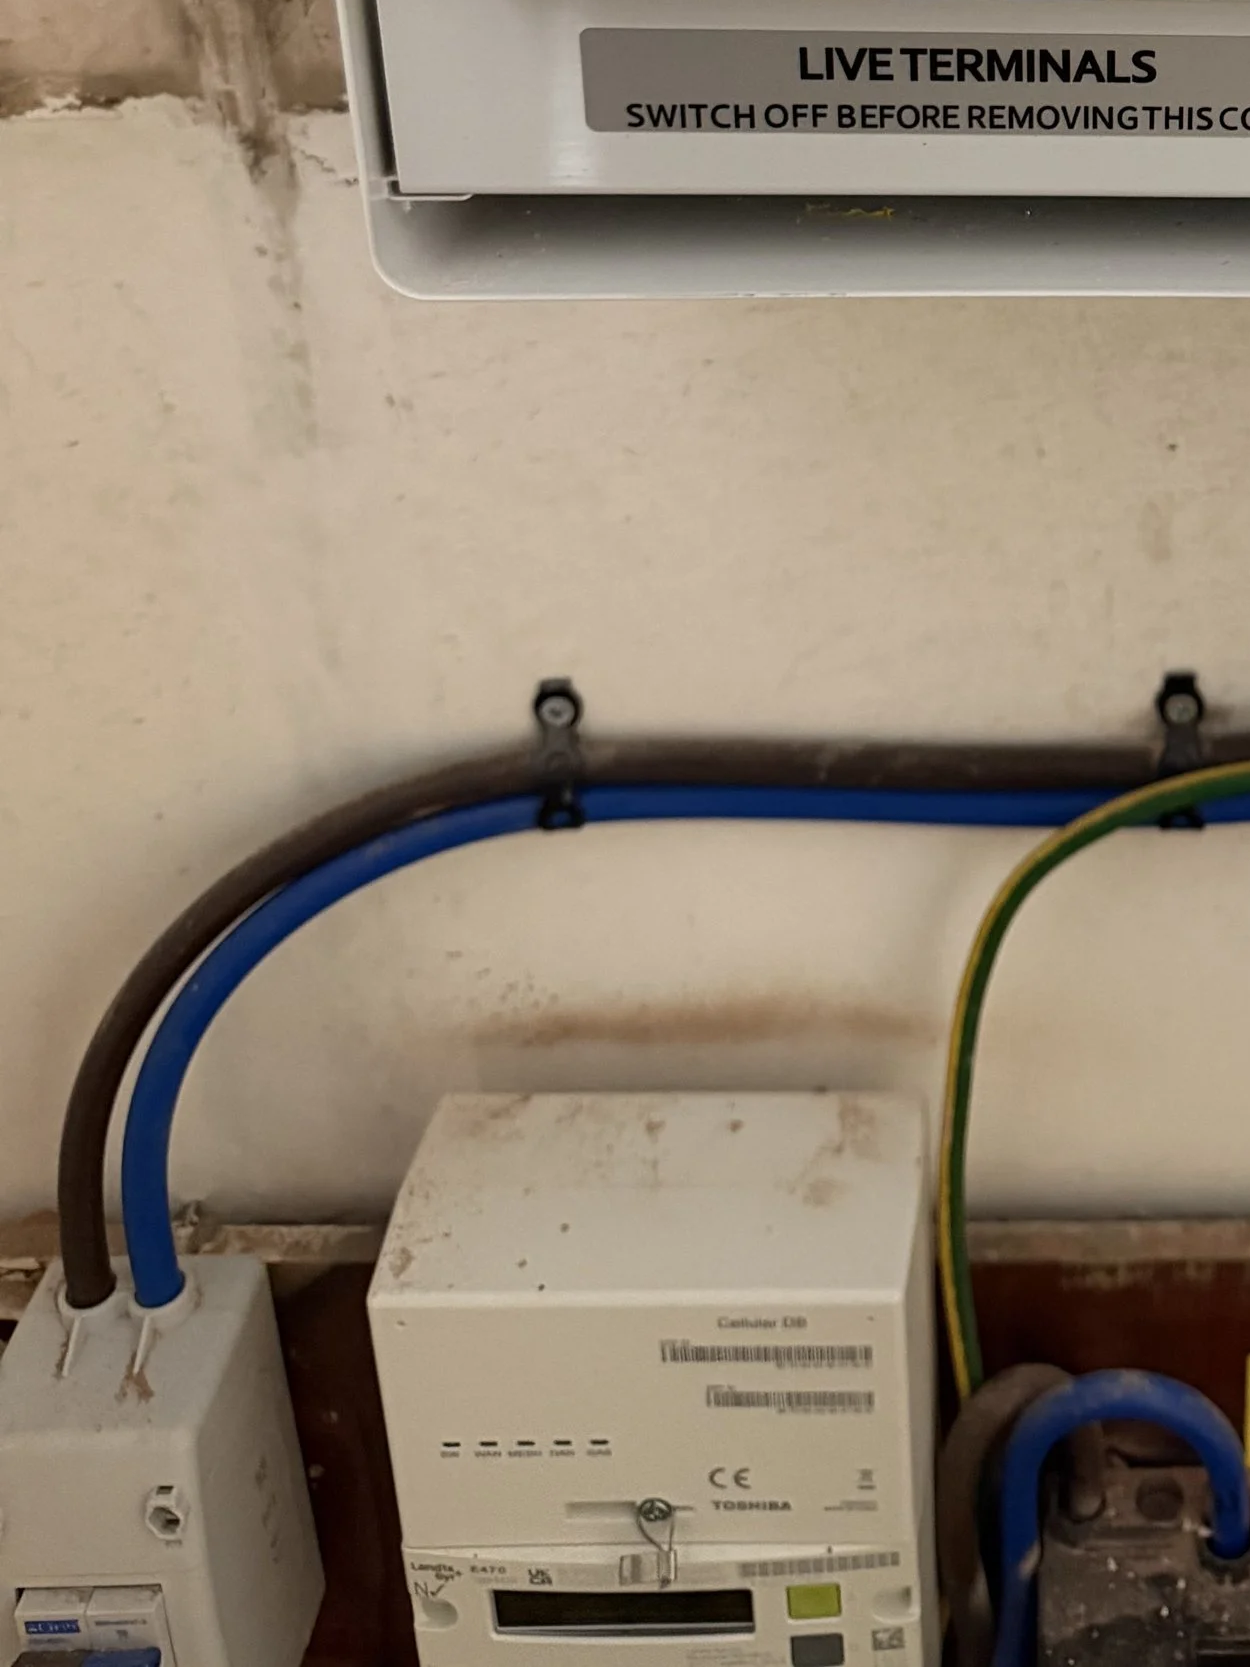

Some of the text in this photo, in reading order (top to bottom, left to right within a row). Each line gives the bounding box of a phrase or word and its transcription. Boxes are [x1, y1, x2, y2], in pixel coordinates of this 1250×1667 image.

[799, 46, 1157, 85] LIVE TERMINALS
[626, 102, 756, 130] SWITCH
[765, 103, 828, 130] OFF
[837, 104, 961, 130] BEFORE
[968, 105, 1141, 132] REMOVING
[1143, 106, 1214, 132] THIS
[711, 1499, 793, 1512] TOSHIBA
